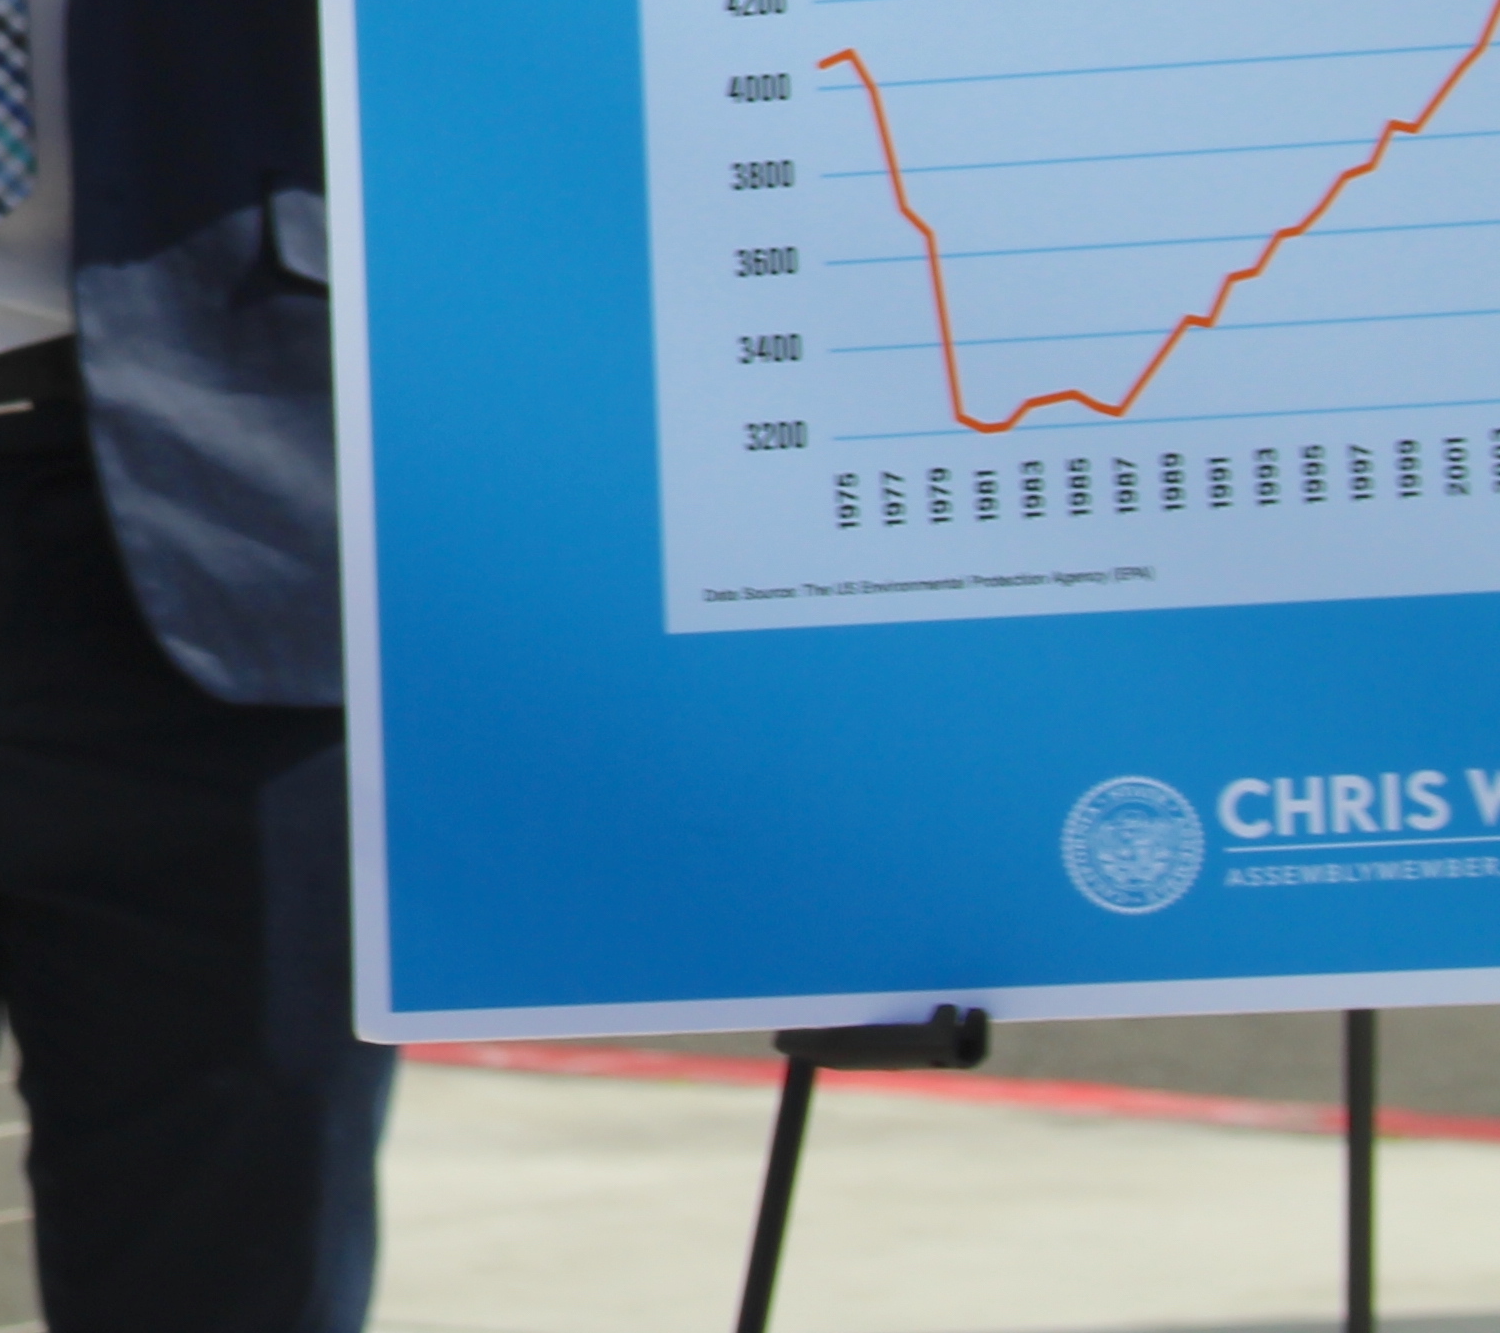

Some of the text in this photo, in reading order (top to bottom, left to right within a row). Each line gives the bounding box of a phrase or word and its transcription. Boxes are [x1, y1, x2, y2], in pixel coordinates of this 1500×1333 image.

[727, 73, 792, 103] 4000
[730, 159, 796, 192] 3800
[734, 246, 800, 278] 3600
[737, 333, 803, 365] 3400
[744, 420, 809, 452] 3200
[927, 466, 954, 524] 1979
[973, 469, 1000, 522] 1981
[1019, 459, 1047, 519] 1983
[1066, 456, 1094, 517] 1985
[1112, 455, 1139, 514] 1987
[1159, 451, 1186, 511] 1989
[1206, 456, 1234, 509] 1991
[1254, 447, 1281, 506] 1993
[1299, 444, 1328, 503] 1995
[1348, 443, 1375, 501] 1997
[1395, 438, 1423, 499] 1999
[1442, 436, 1472, 497] 2001
[834, 471, 862, 530] 1975
[880, 470, 907, 527] 1977
[1217, 768, 1452, 840] CHRIS
